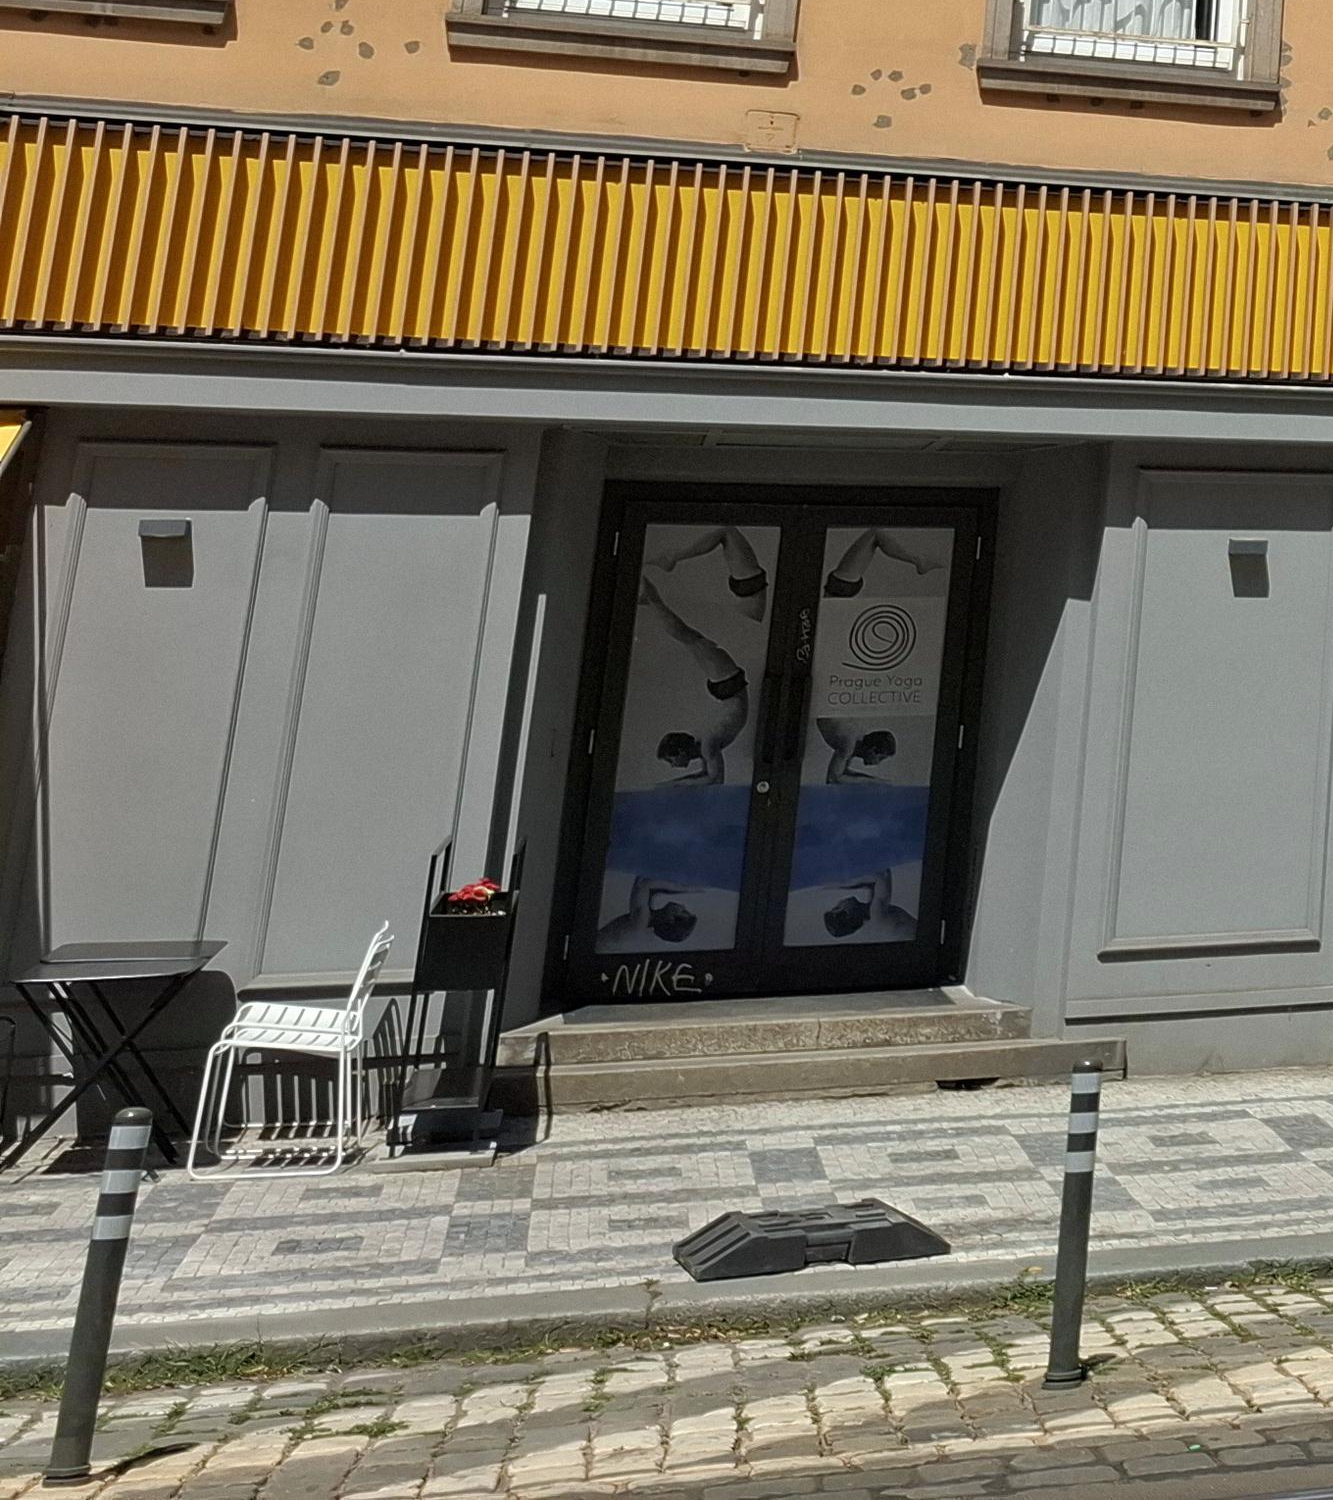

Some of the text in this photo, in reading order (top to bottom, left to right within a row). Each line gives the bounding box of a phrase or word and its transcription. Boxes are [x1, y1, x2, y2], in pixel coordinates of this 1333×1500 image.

[829, 674, 923, 691] Prague Yoga
[828, 691, 921, 705] COLLECTIVE
